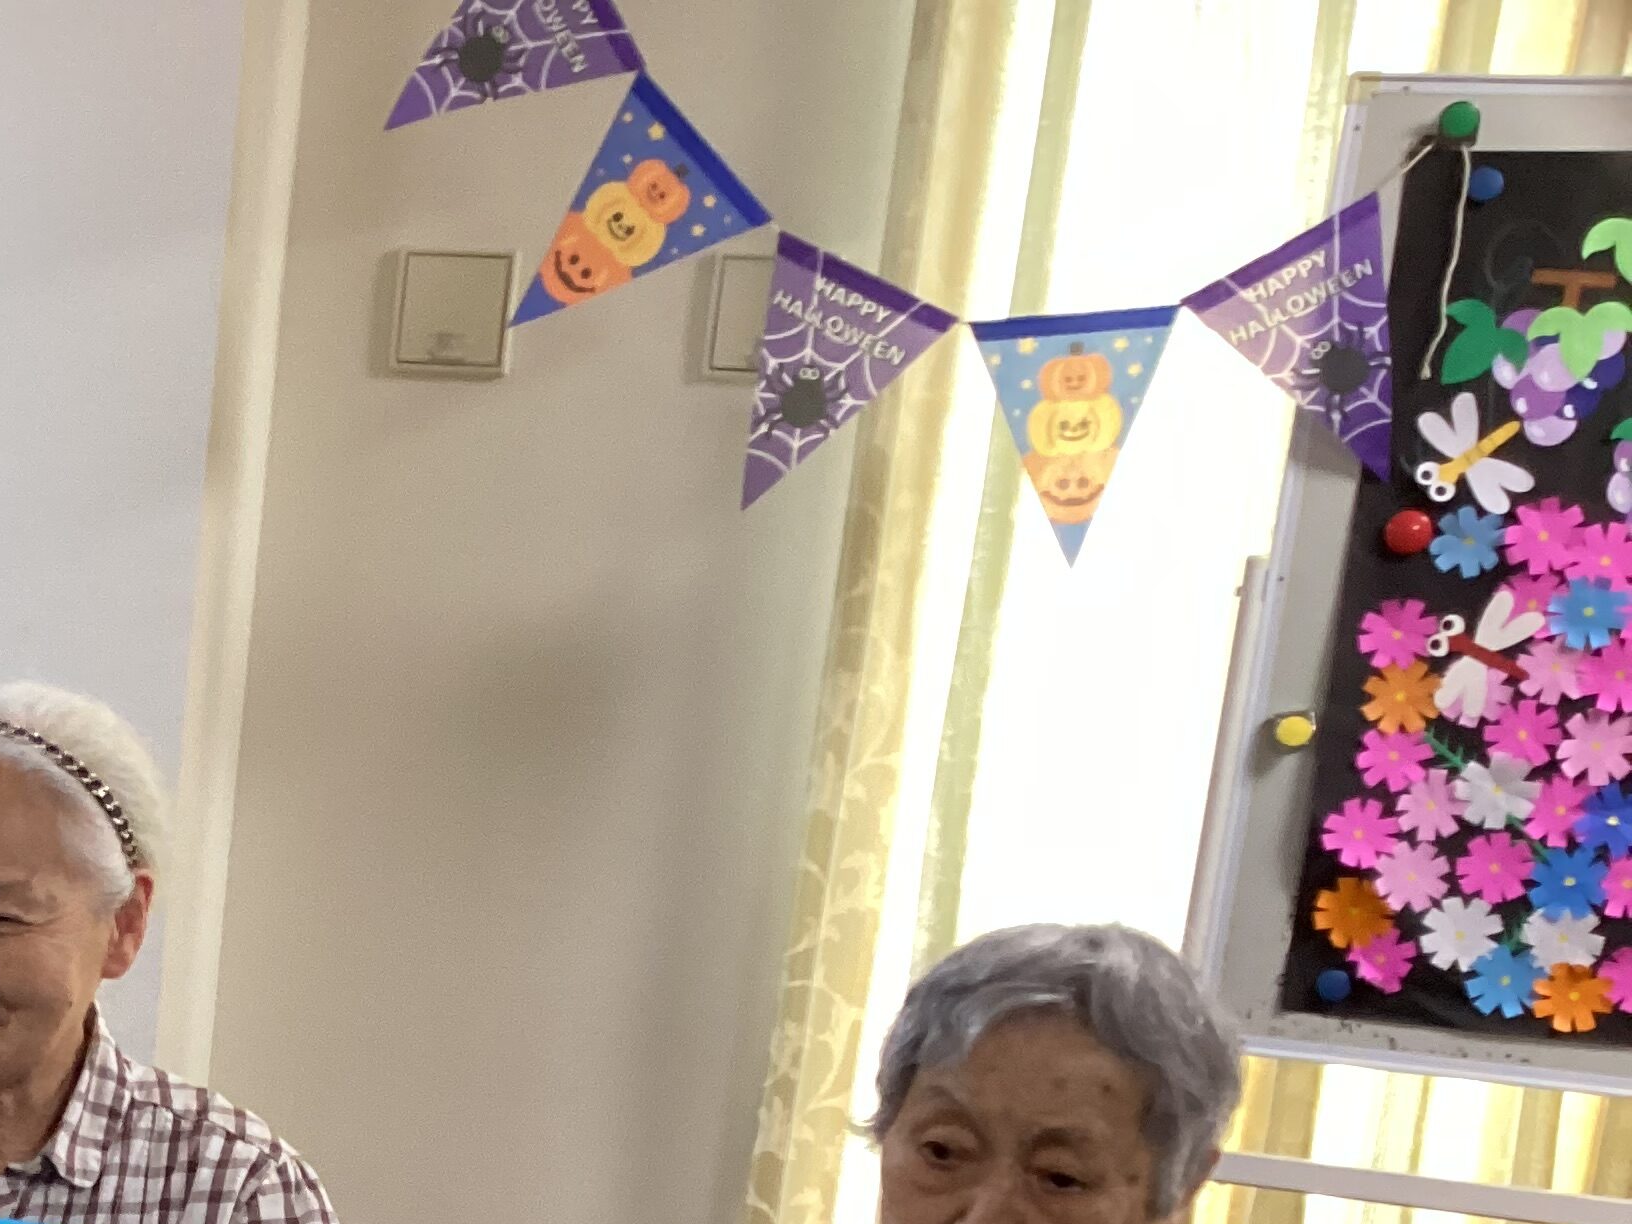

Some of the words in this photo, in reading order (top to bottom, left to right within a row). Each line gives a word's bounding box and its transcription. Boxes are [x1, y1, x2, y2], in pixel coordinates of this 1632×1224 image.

[814, 276, 892, 323] HAPPY
[1229, 259, 1373, 345] HALLOWEEN
[1241, 250, 1326, 303] HAPPY
[773, 290, 906, 366] HALLOWEEN
